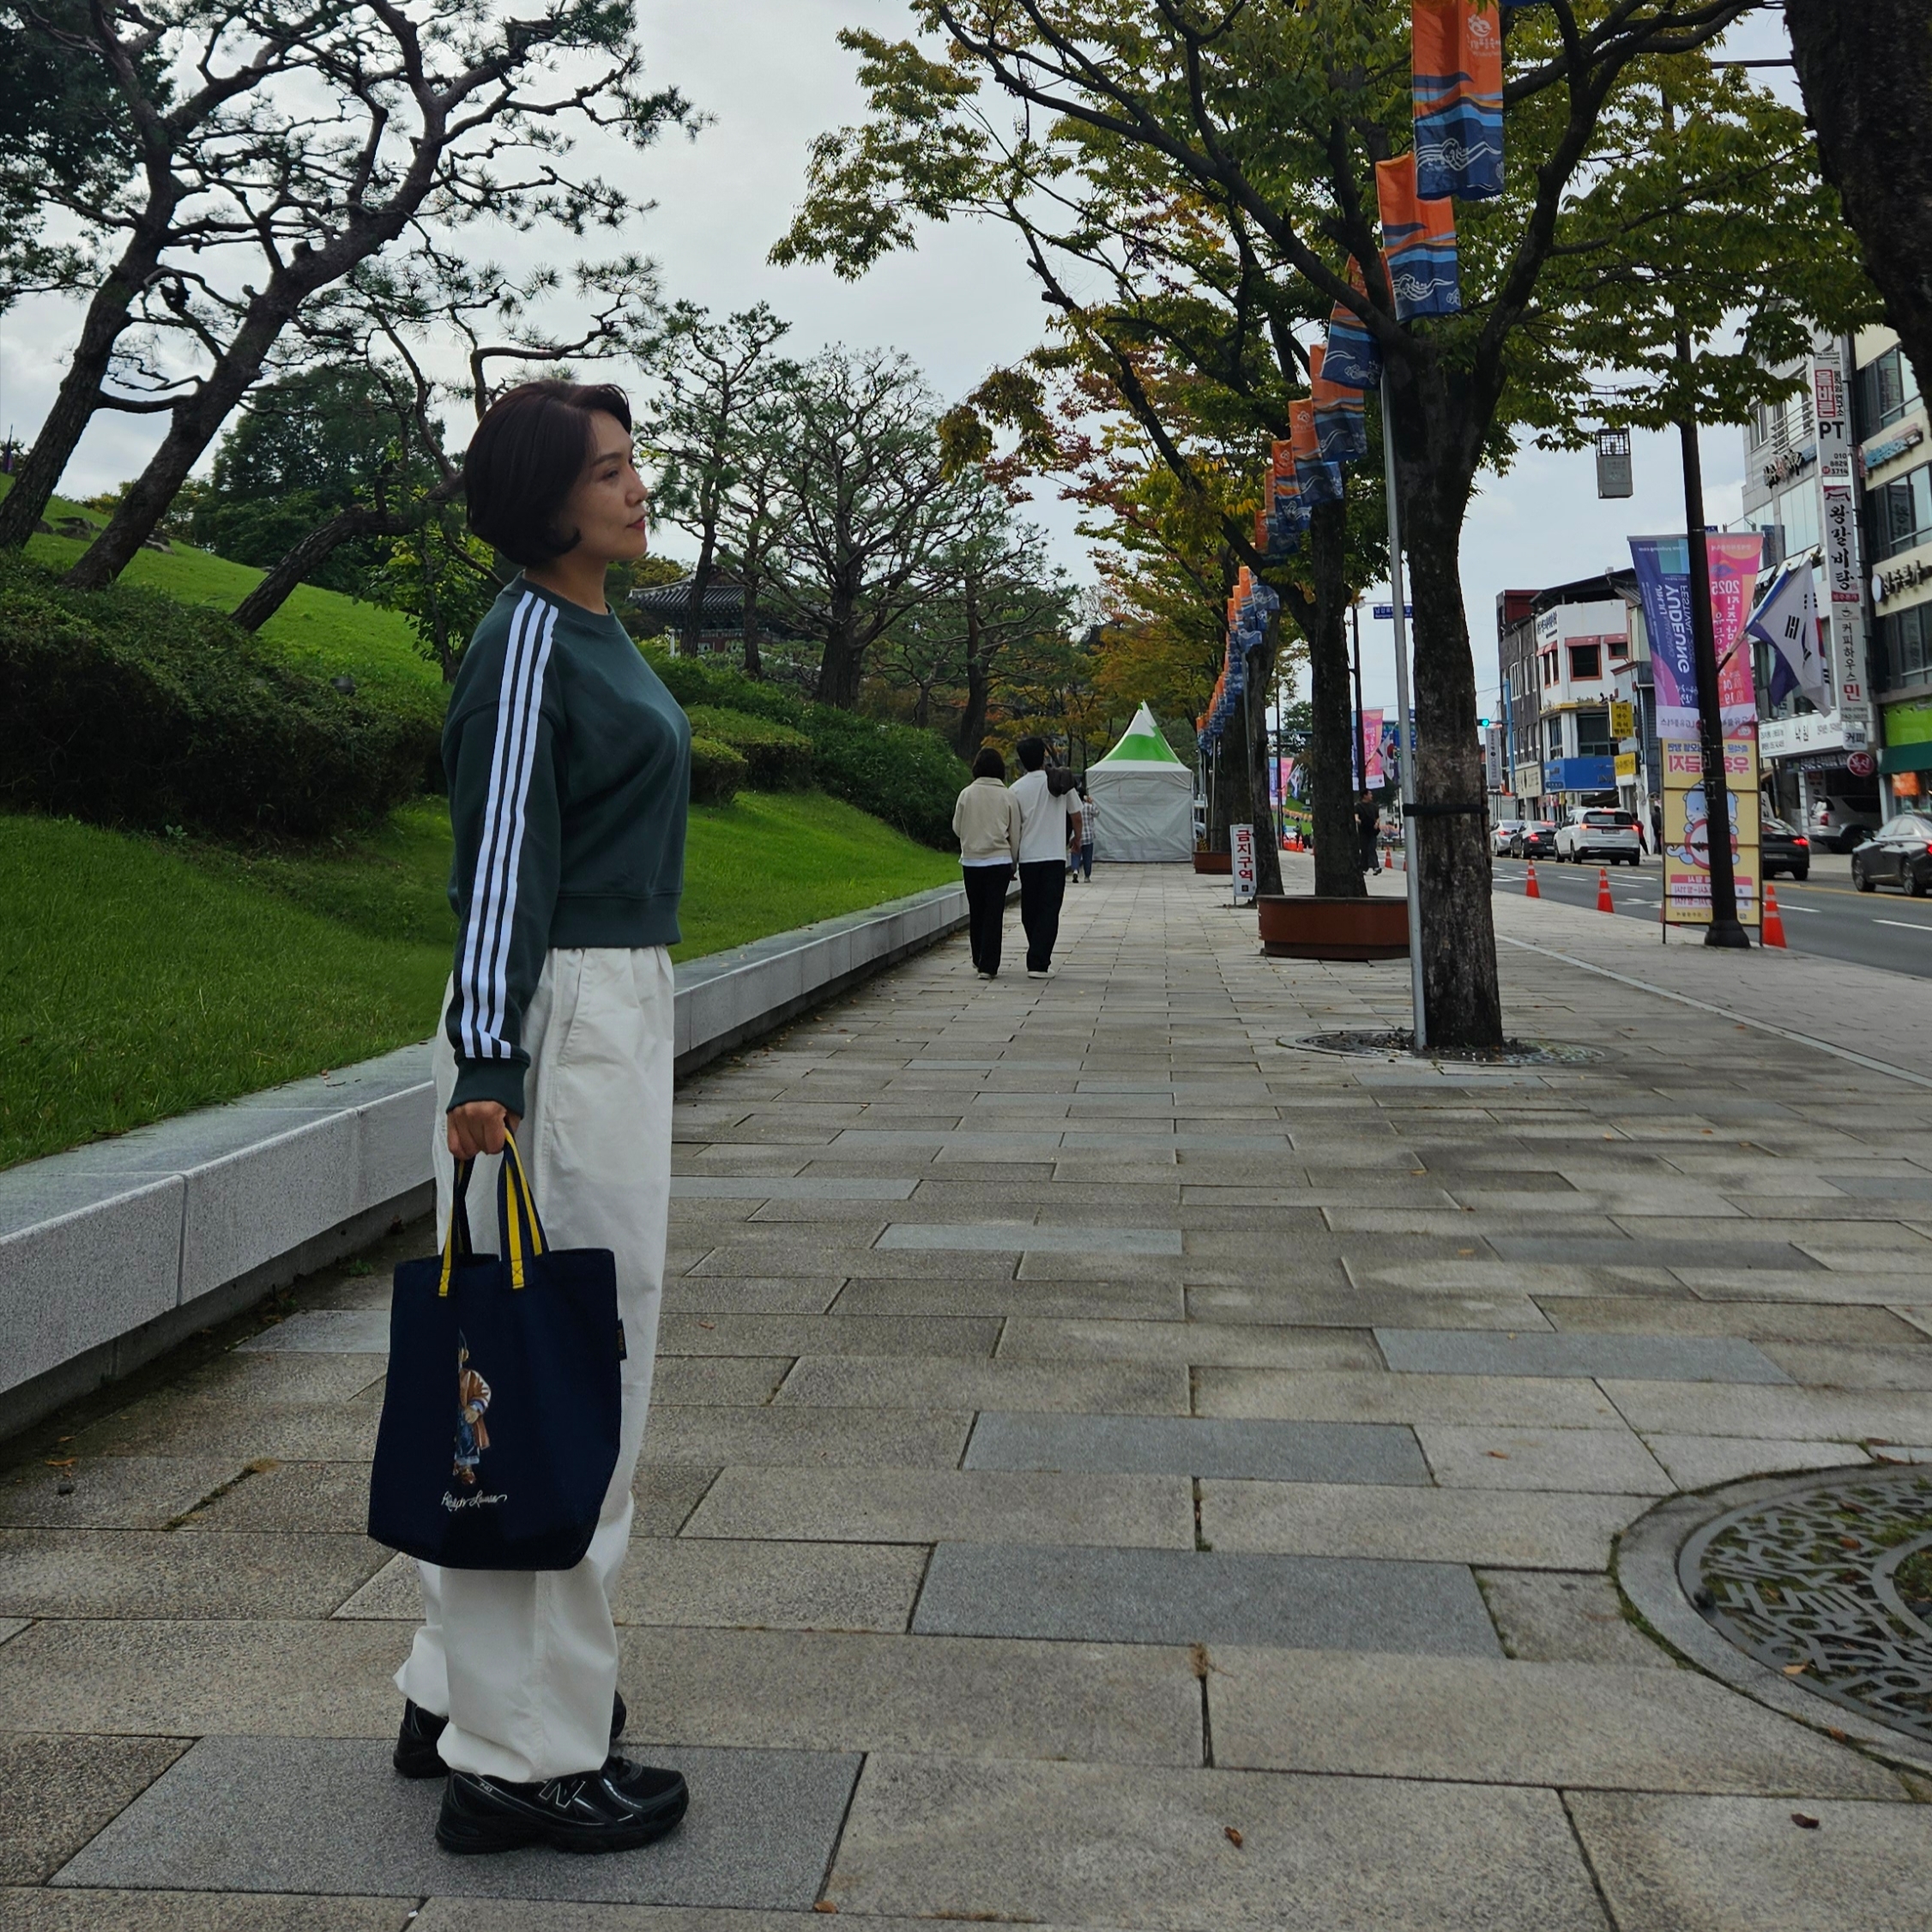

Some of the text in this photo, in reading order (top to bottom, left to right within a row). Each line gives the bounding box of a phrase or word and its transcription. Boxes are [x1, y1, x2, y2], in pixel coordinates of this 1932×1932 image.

[1819, 421, 1844, 439] PT
[1829, 504, 1855, 591] 왕갈비탕
[1842, 622, 1857, 682] 커피하우스
[1844, 684, 1860, 702] 민
[1845, 732, 1866, 744] 커피
[1235, 830, 1253, 882] 금지구역
